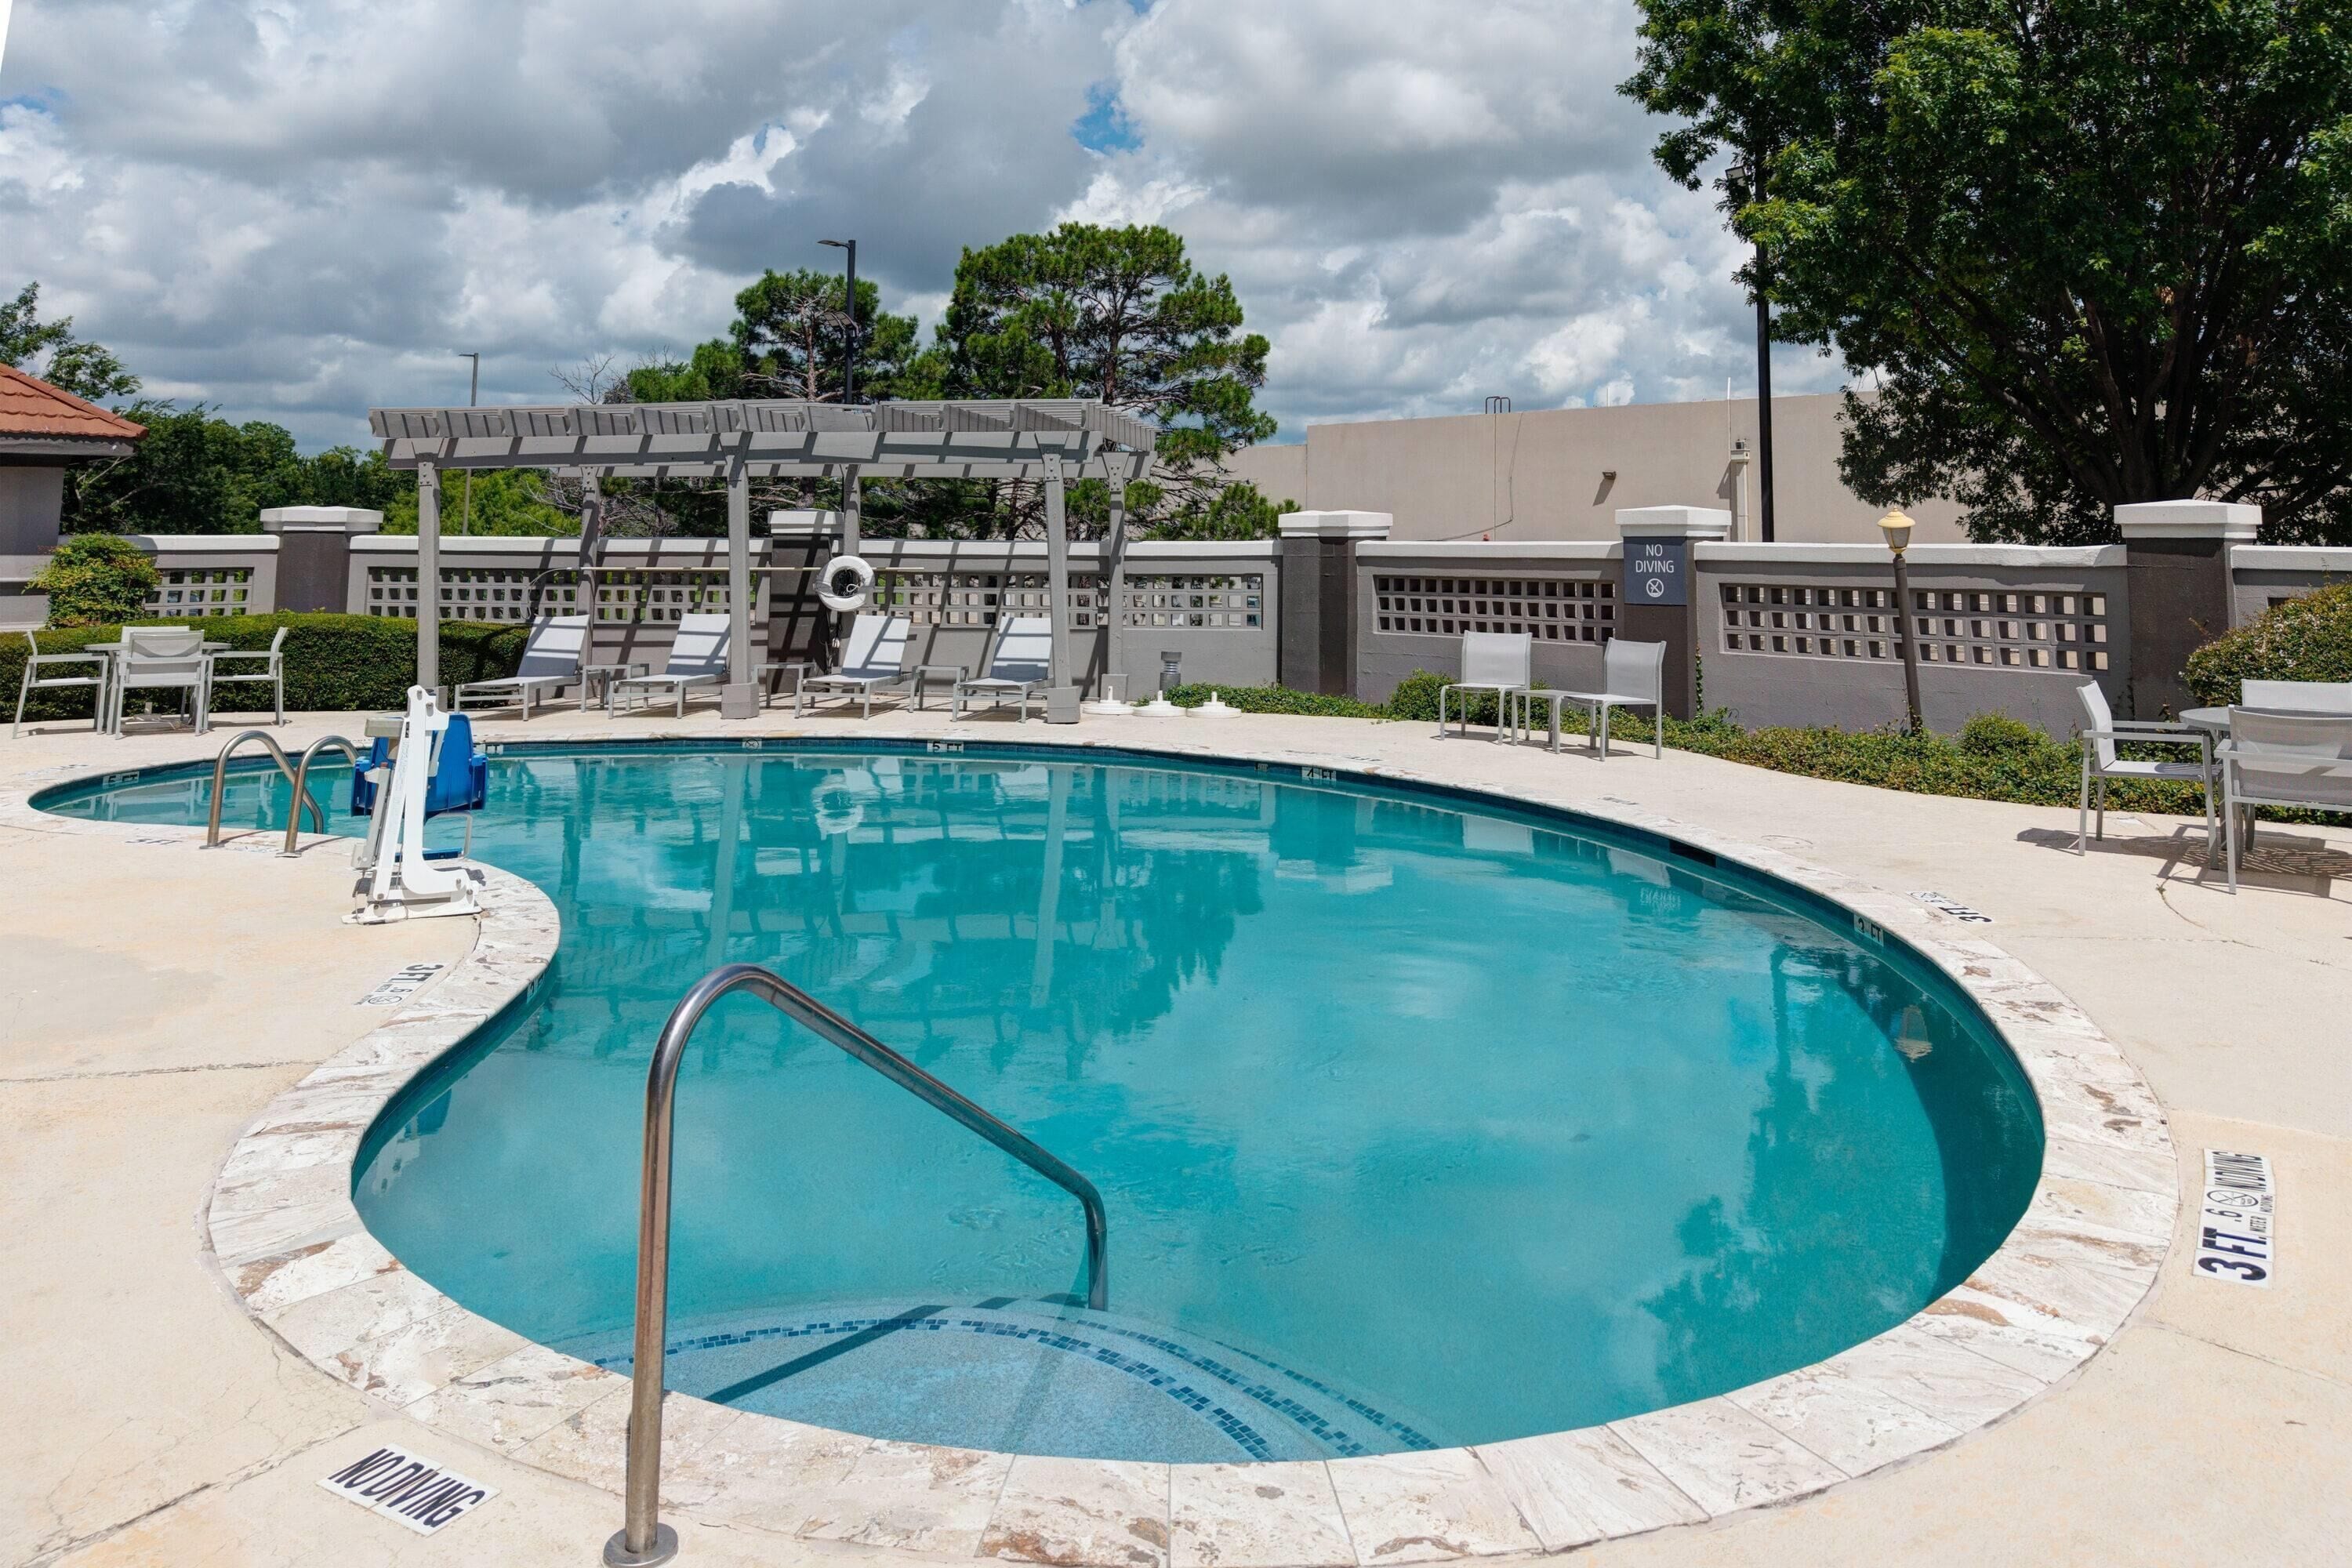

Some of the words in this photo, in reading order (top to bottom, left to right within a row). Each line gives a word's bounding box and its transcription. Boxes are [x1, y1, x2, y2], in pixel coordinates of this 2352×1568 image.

[1646, 544, 1663, 557] NO
[1635, 560, 1675, 573] DIVING
[932, 741, 941, 750] 5
[2212, 1151, 2267, 1181] DIVING
[2214, 1178, 2267, 1192] NO
[328, 1448, 406, 1489] NO
[359, 1461, 486, 1528] DIVING
